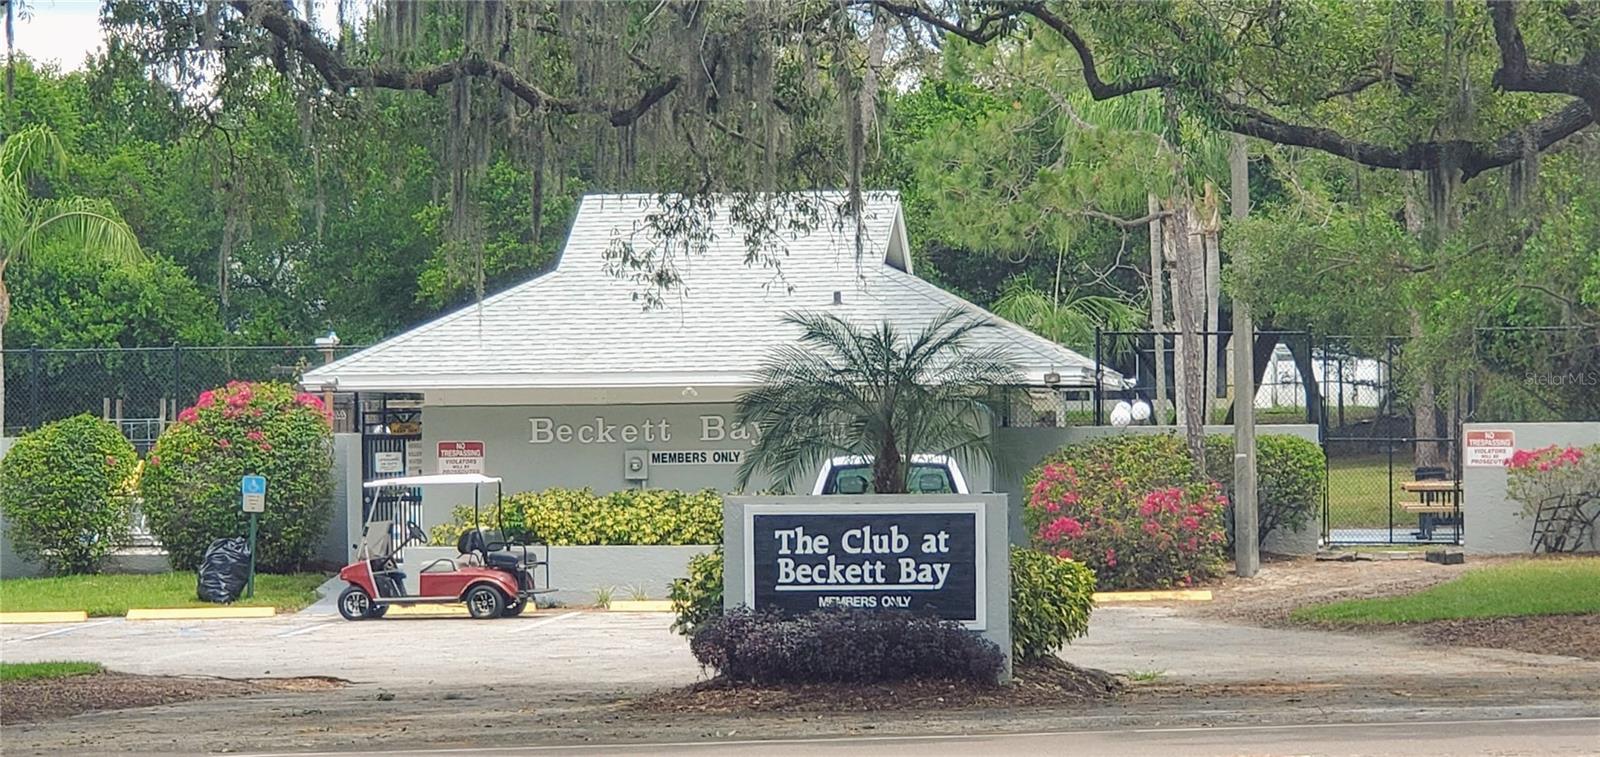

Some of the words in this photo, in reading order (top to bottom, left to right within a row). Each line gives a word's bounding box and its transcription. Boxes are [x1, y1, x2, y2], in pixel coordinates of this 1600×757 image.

[528, 418, 671, 443] Beckett
[699, 415, 768, 446] Bay
[440, 449, 481, 457] TRESPASSING
[652, 451, 707, 464] MEMBERS
[713, 451, 741, 463] ONLY
[774, 526, 829, 555] The
[841, 525, 909, 554] Club
[921, 530, 950, 553] at
[777, 555, 886, 584] Beckett
[898, 558, 951, 590] Bay
[881, 596, 912, 608] ONLY
